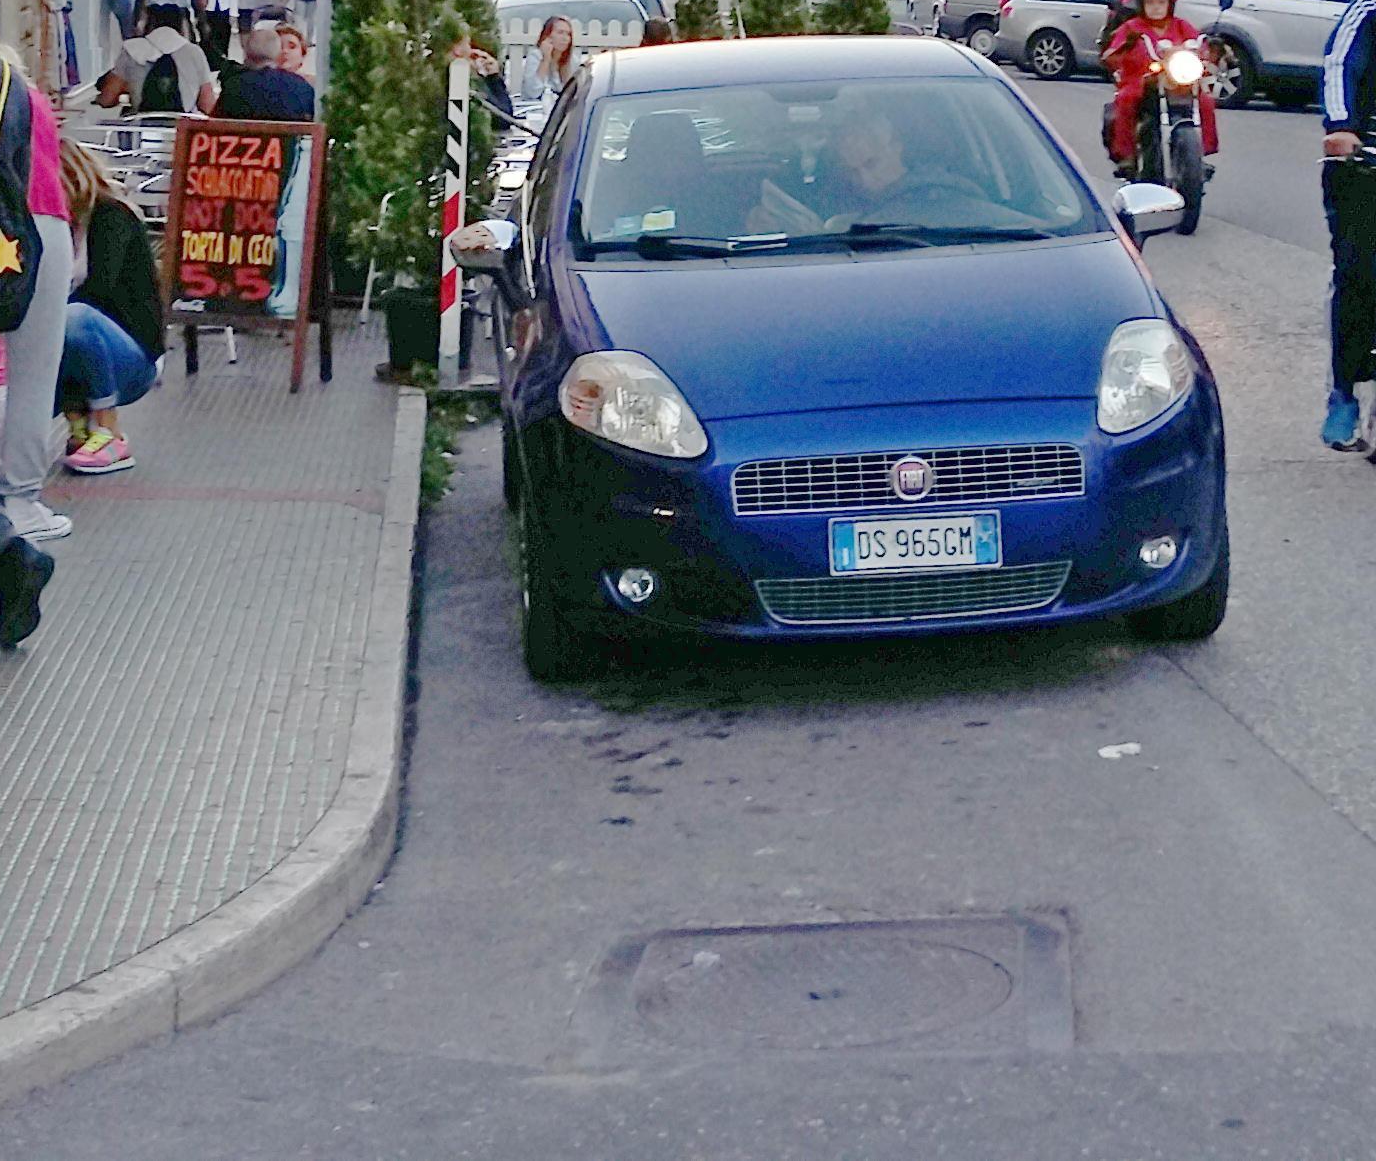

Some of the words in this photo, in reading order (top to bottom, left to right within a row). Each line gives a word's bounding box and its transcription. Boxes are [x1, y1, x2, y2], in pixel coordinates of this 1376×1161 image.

[189, 133, 283, 169] PIZZA
[181, 229, 225, 263] TORTA
[228, 234, 244, 265] DI
